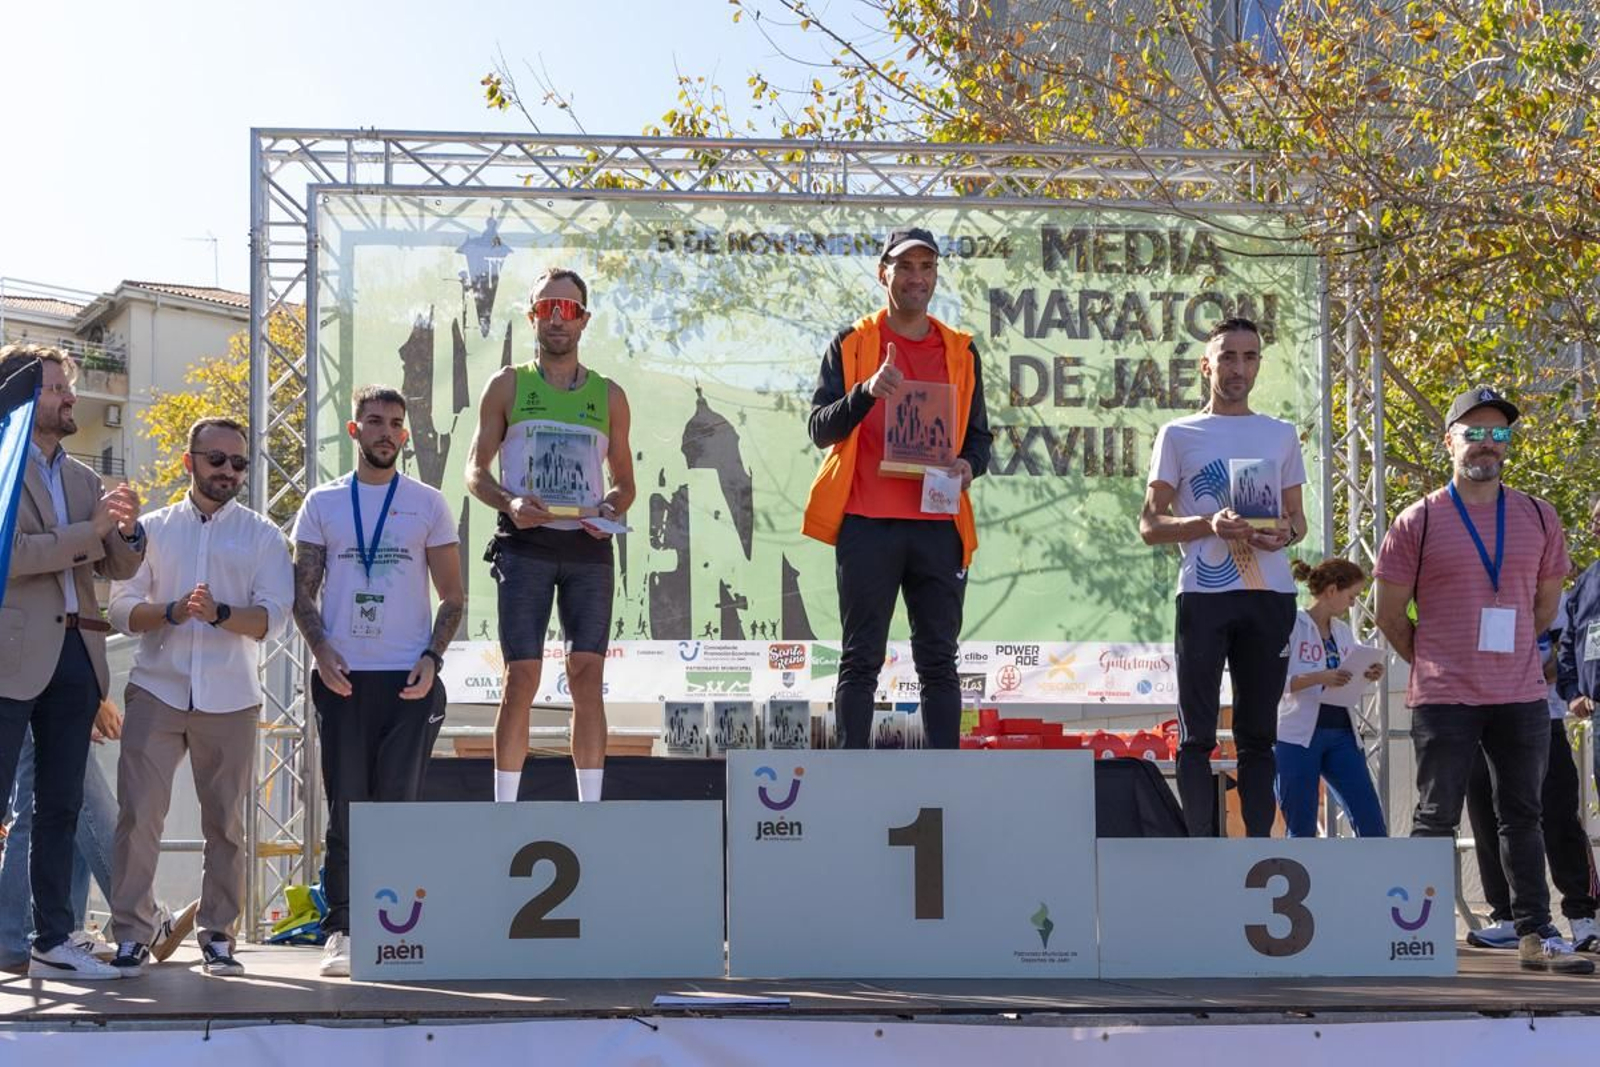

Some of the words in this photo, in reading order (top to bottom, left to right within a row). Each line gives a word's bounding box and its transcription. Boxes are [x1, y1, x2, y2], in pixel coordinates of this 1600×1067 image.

[683, 230, 721, 255] DE
[728, 231, 884, 256] NOVIEMBRE
[938, 234, 1013, 259] 2024
[1041, 223, 1225, 275] MEDIA
[1009, 355, 1085, 407] DE
[1099, 343, 1213, 409] JAÉ
[778, 655, 806, 671] Reino
[964, 652, 988, 661] clibo
[996, 645, 1040, 656] POWER
[1015, 656, 1039, 666] ADE
[755, 815, 802, 841] jaén
[888, 807, 945, 920] 1
[508, 840, 581, 939] 2
[1244, 857, 1315, 957] 3
[375, 939, 424, 966] jaén
